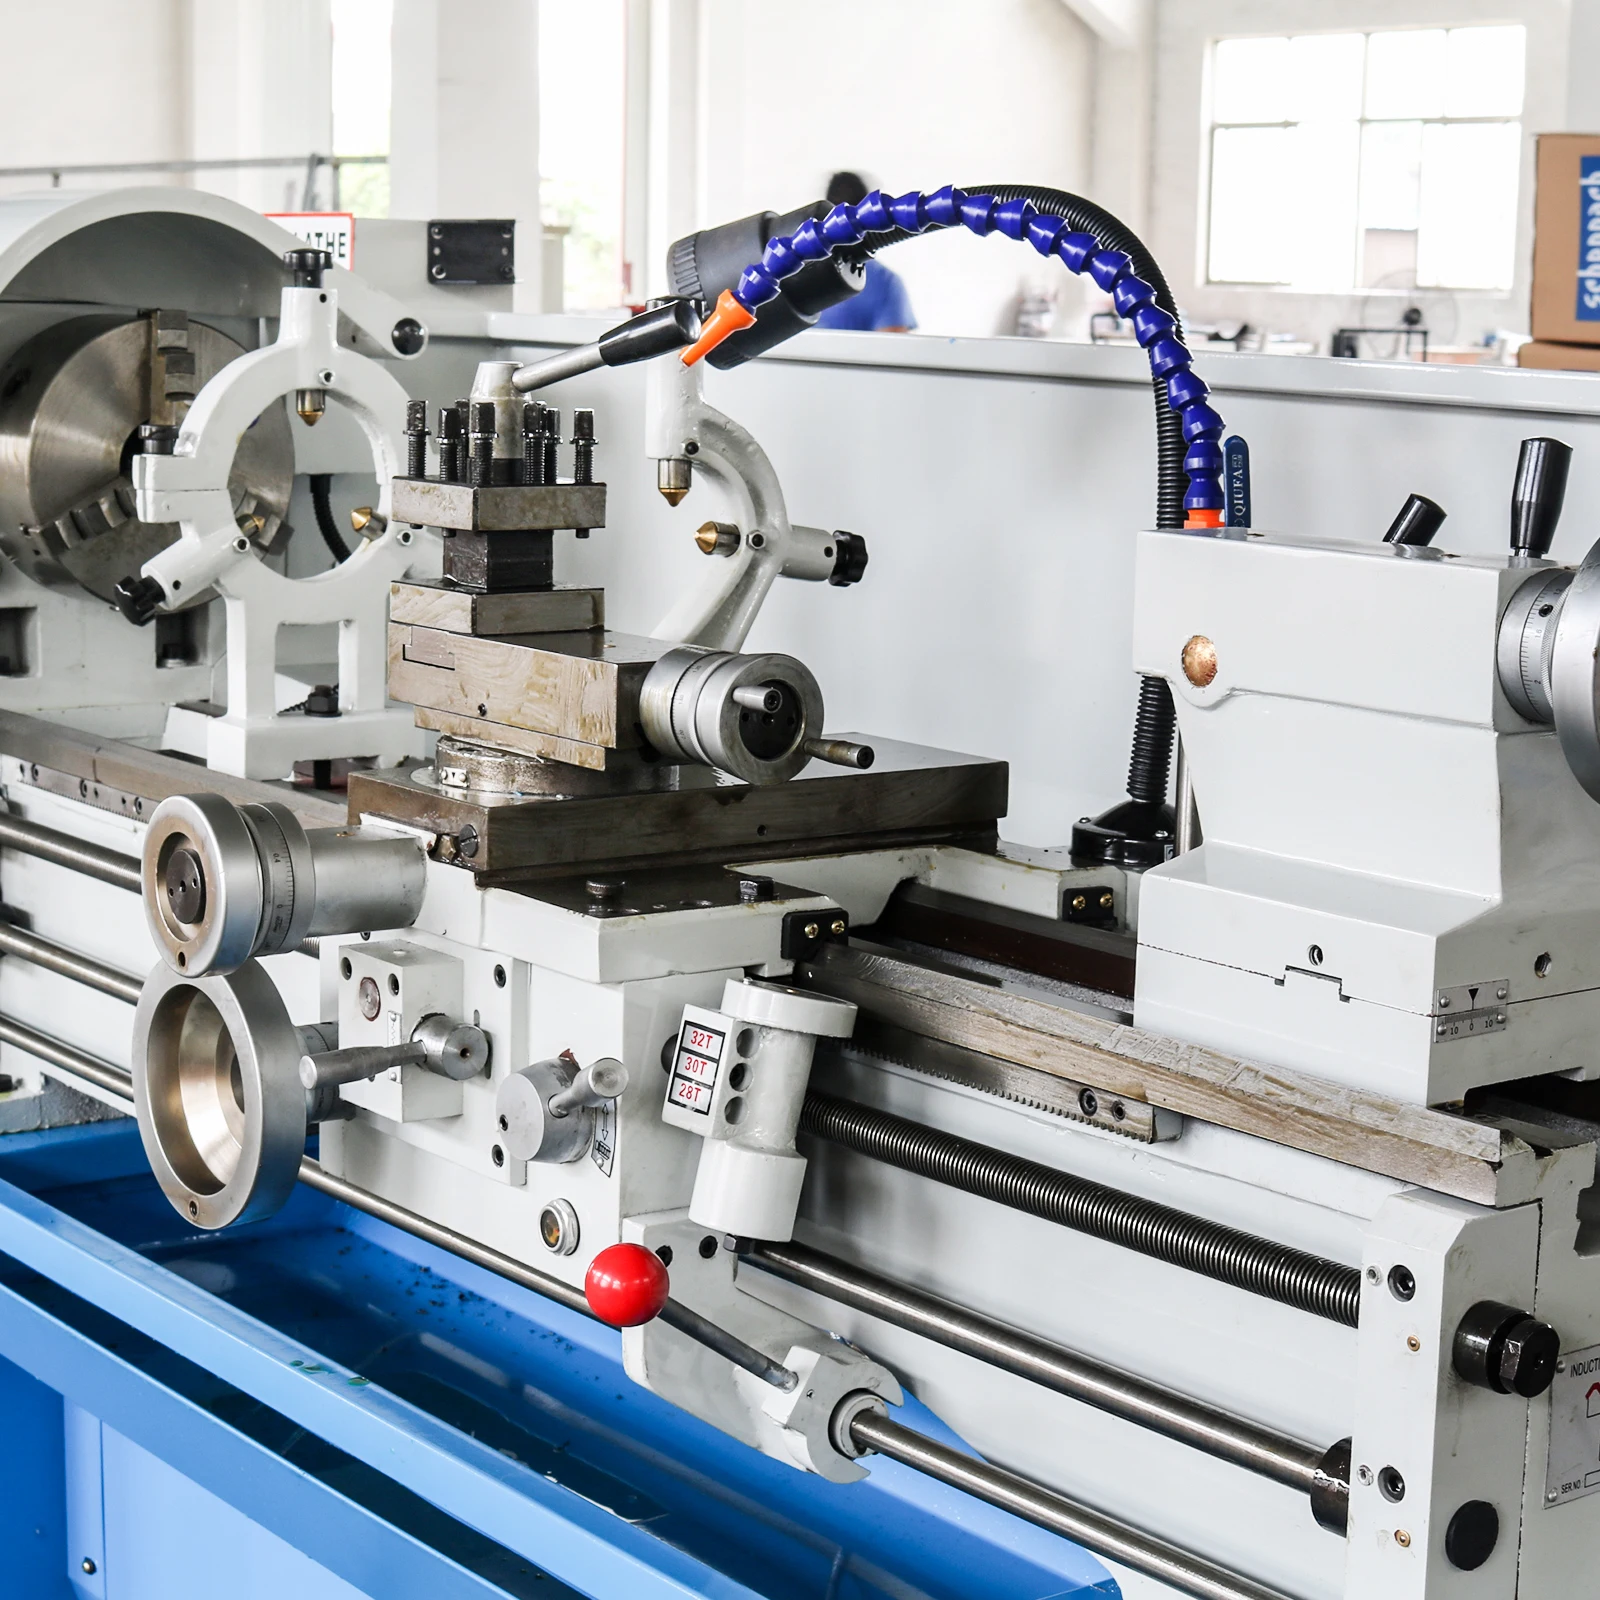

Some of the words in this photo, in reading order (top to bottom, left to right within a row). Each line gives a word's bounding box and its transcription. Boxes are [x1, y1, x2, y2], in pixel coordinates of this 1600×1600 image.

[1233, 469, 1246, 515] QIUFA
[1450, 1026, 1459, 1036] 10
[1485, 1019, 1493, 1029] 10
[690, 1030, 713, 1049] 32T
[684, 1056, 707, 1076] 30T
[679, 1083, 702, 1102] 28T
